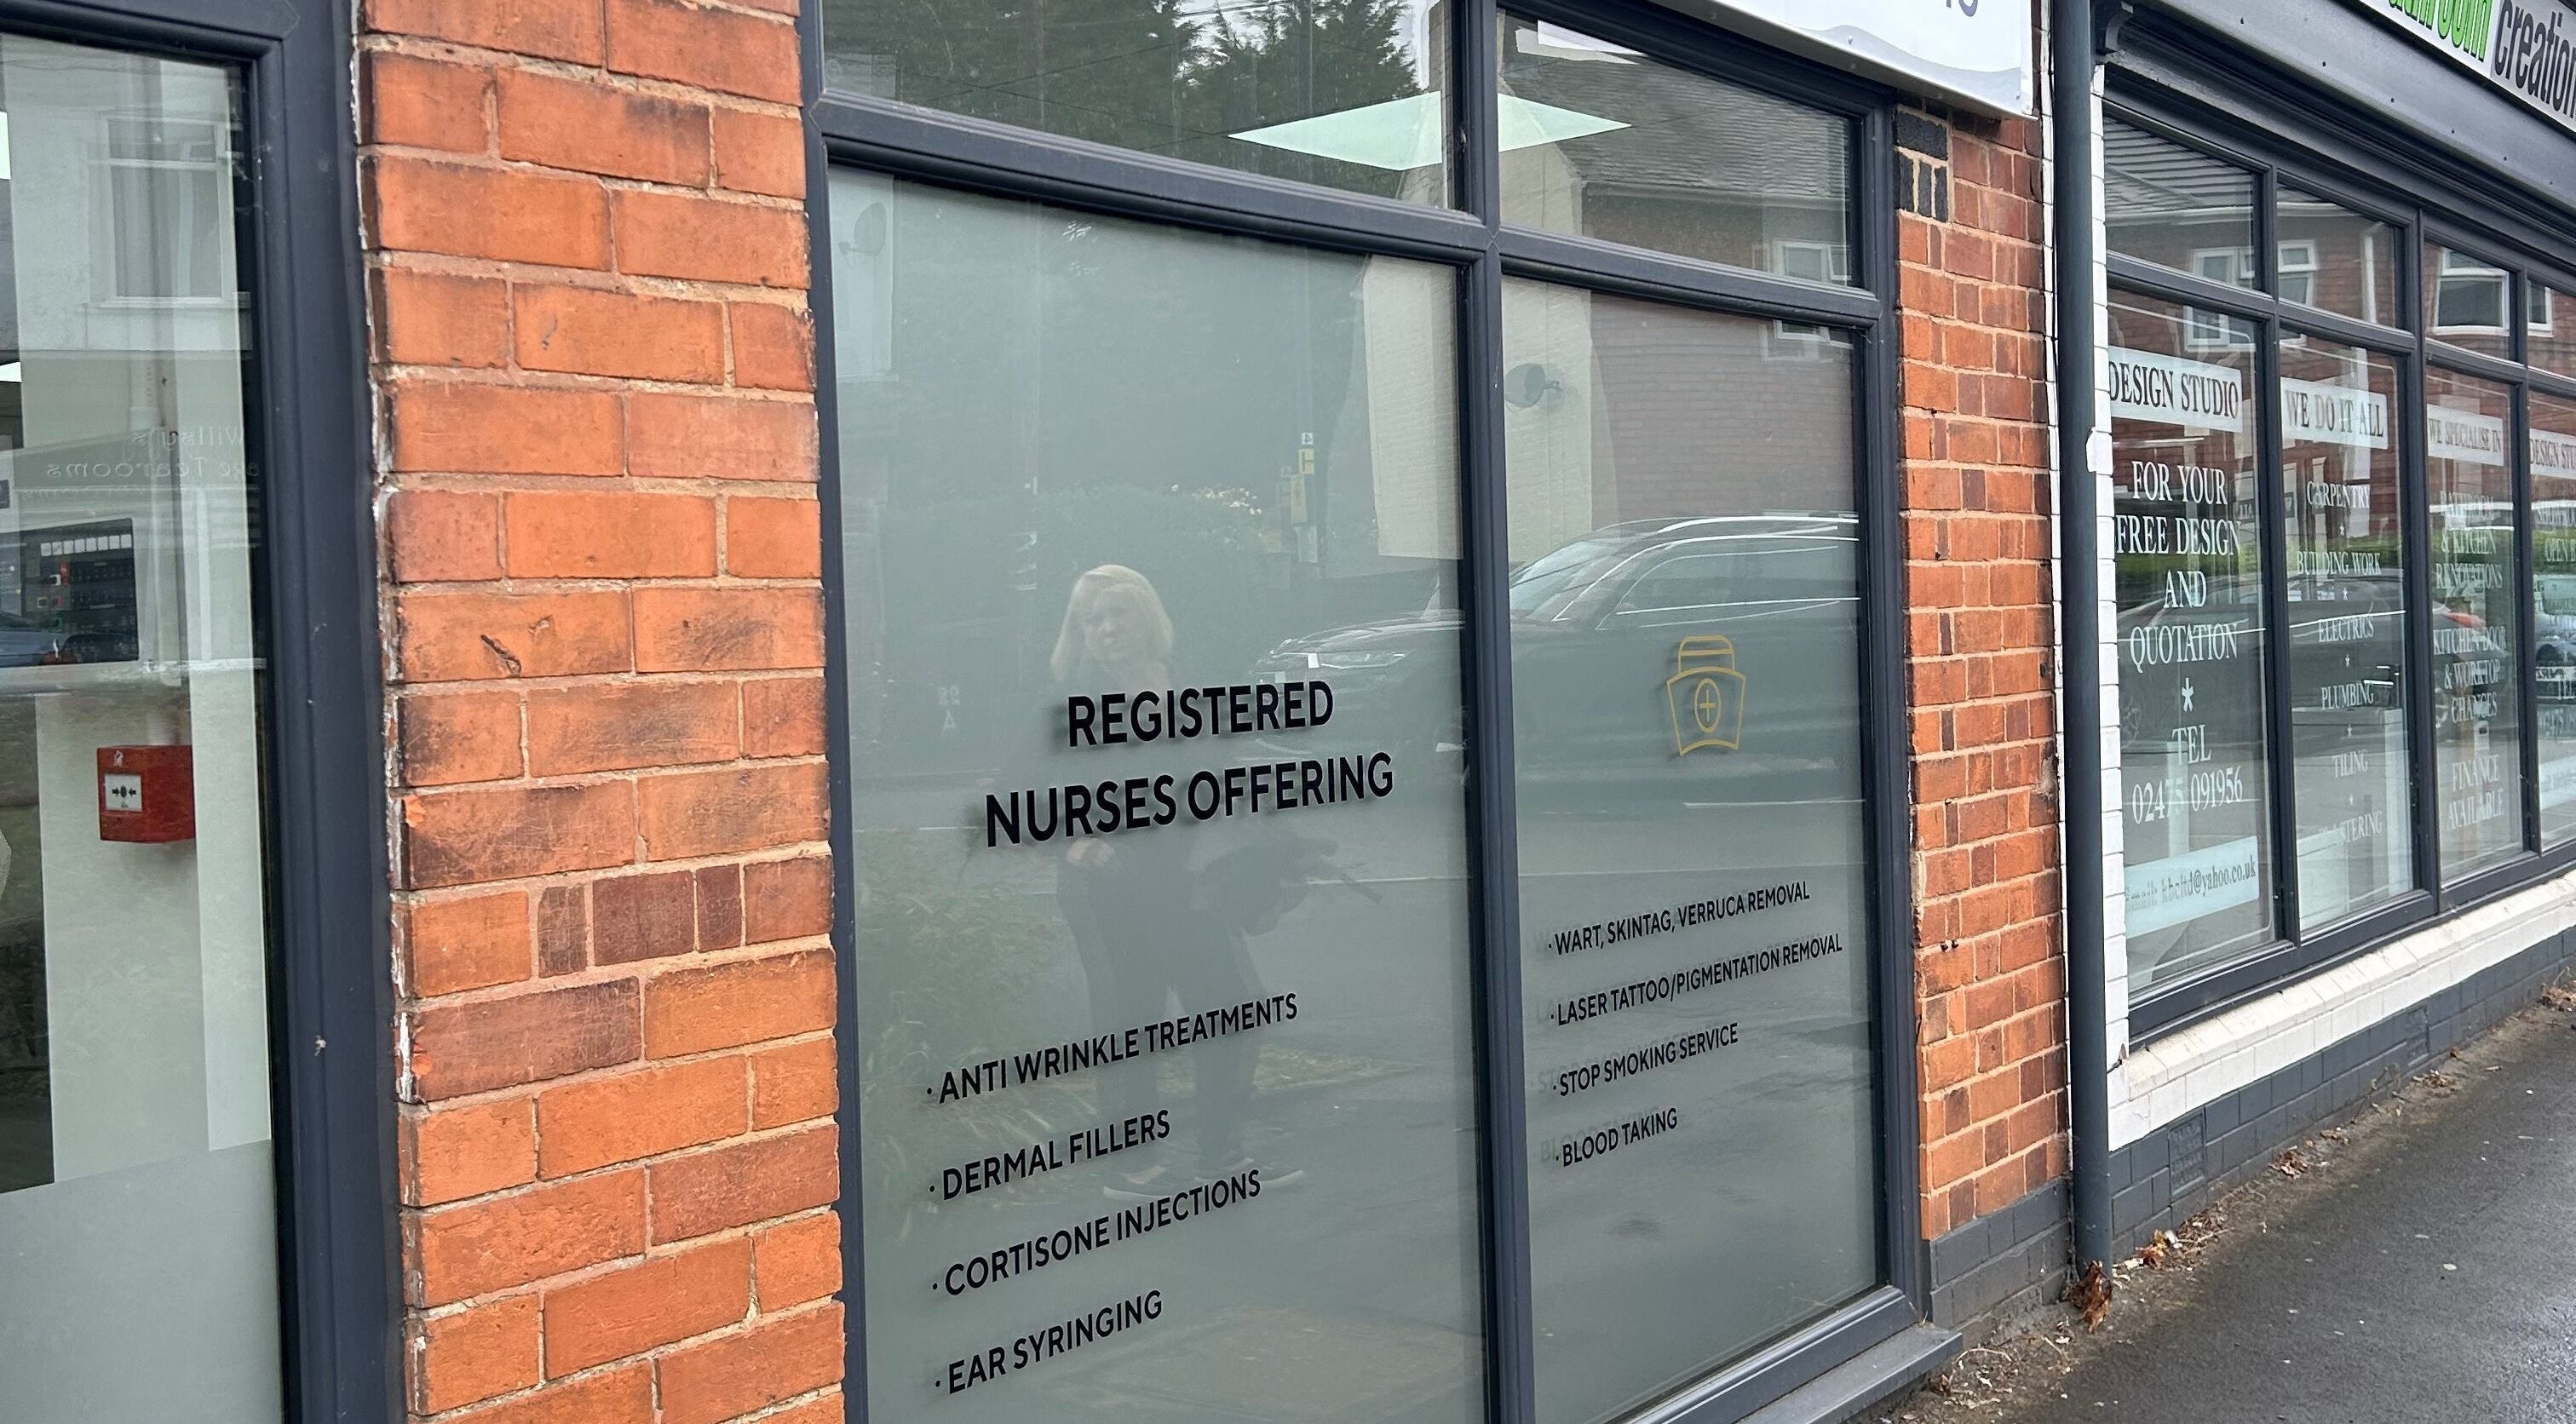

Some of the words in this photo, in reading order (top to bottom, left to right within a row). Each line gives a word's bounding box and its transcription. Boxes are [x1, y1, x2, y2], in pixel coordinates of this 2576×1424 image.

[2109, 361, 2175, 410] DESIGN
[2181, 372, 2238, 419] STUDIO
[2286, 390, 2310, 428] WE
[2314, 394, 2335, 432] DO
[2339, 398, 2355, 433] IT
[2359, 401, 2384, 438] ALL
[2131, 461, 2172, 501] FOR
[2177, 465, 2228, 505] YOUR
[2307, 480, 2371, 509] CARPENTRY
[2116, 514, 2170, 554] FREE
[2176, 518, 2242, 556] DESIGN
[2297, 551, 2349, 576] BUILDING
[2351, 552, 2382, 576] WORK
[2164, 570, 2207, 608] AND
[2130, 623, 2238, 674] QUOTATION
[2318, 615, 2374, 643] ELECTRICS
[2482, 626, 2507, 652] DOOR
[1067, 680, 1335, 748] REGISTERED
[2320, 681, 2374, 710] PLUMBING
[2172, 724, 2212, 766] TEL
[2332, 749, 2369, 778] TILING
[2190, 766, 2244, 812] 091956
[2452, 753, 2499, 792] FINANCE
[986, 774, 1177, 848] NURSES
[1187, 751, 1394, 821] OFFERING
[1554, 923, 1605, 956] WART,
[1607, 909, 1676, 944] SKINTAG,
[1677, 894, 1745, 928] VERRUCA
[1747, 880, 1810, 911] REMOVAL
[1557, 991, 1608, 1026] LASER
[1610, 947, 1780, 1012] TATTOO/PIGMENTATION
[1782, 933, 1843, 966] REMOVAL
[939, 1059, 1008, 1105] ANTI
[1014, 1027, 1141, 1085] WRINKLE
[1144, 992, 1299, 1050] TREATMENTS
[1560, 1064, 1601, 1097] STOP
[1603, 1040, 1676, 1084] SMOKING
[1679, 1022, 1739, 1059] SERVICE
[942, 1140, 1063, 1201] DERMAL
[1069, 1109, 1171, 1164] FILLERS
[1561, 1127, 1619, 1168] BLOOD
[1621, 1107, 1678, 1146] TAKING
[944, 1216, 1111, 1296] CORTISONE
[1116, 1169, 1262, 1242] INJECTIONS
[948, 1345, 1007, 1395] EAR
[1013, 1289, 1164, 1369] SYRINGING
